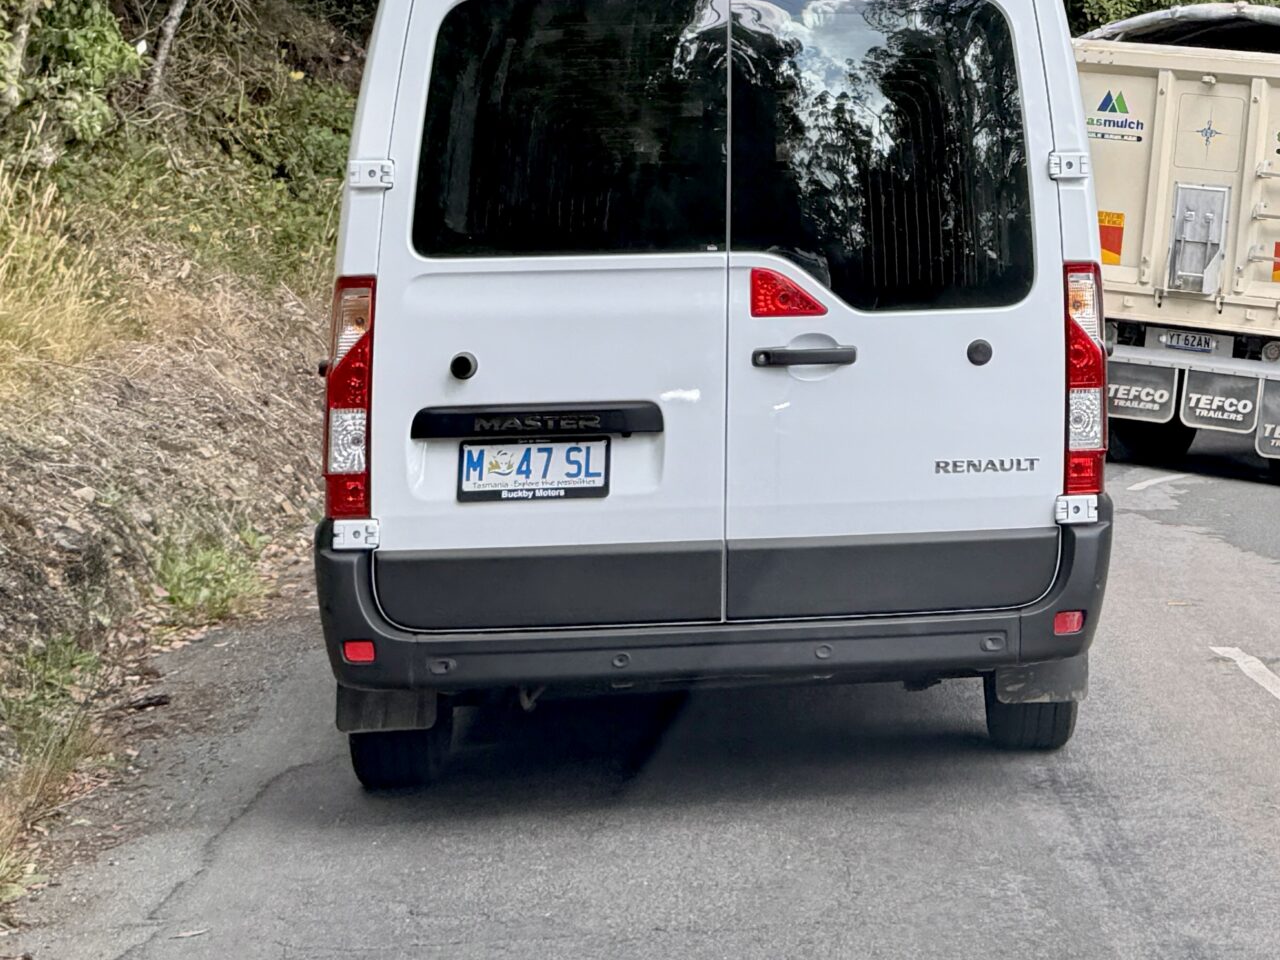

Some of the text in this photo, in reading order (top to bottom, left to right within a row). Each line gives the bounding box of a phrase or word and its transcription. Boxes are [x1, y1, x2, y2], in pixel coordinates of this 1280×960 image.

[1086, 117, 1144, 130] asmulch
[1168, 333, 1182, 345] YT
[1108, 384, 1170, 403] TEFCO
[1114, 399, 1160, 411] TRAILERS
[1188, 393, 1253, 412] TEFCO
[1195, 409, 1244, 422] TRAILERS
[474, 415, 601, 431] MASTER
[515, 447, 554, 480] 47
[564, 446, 602, 479] SL
[934, 458, 1040, 474] RENAULT
[472, 481, 509, 489] Tasmania
[514, 480, 539, 489] Explore
[501, 488, 566, 499] Buckby Motors
